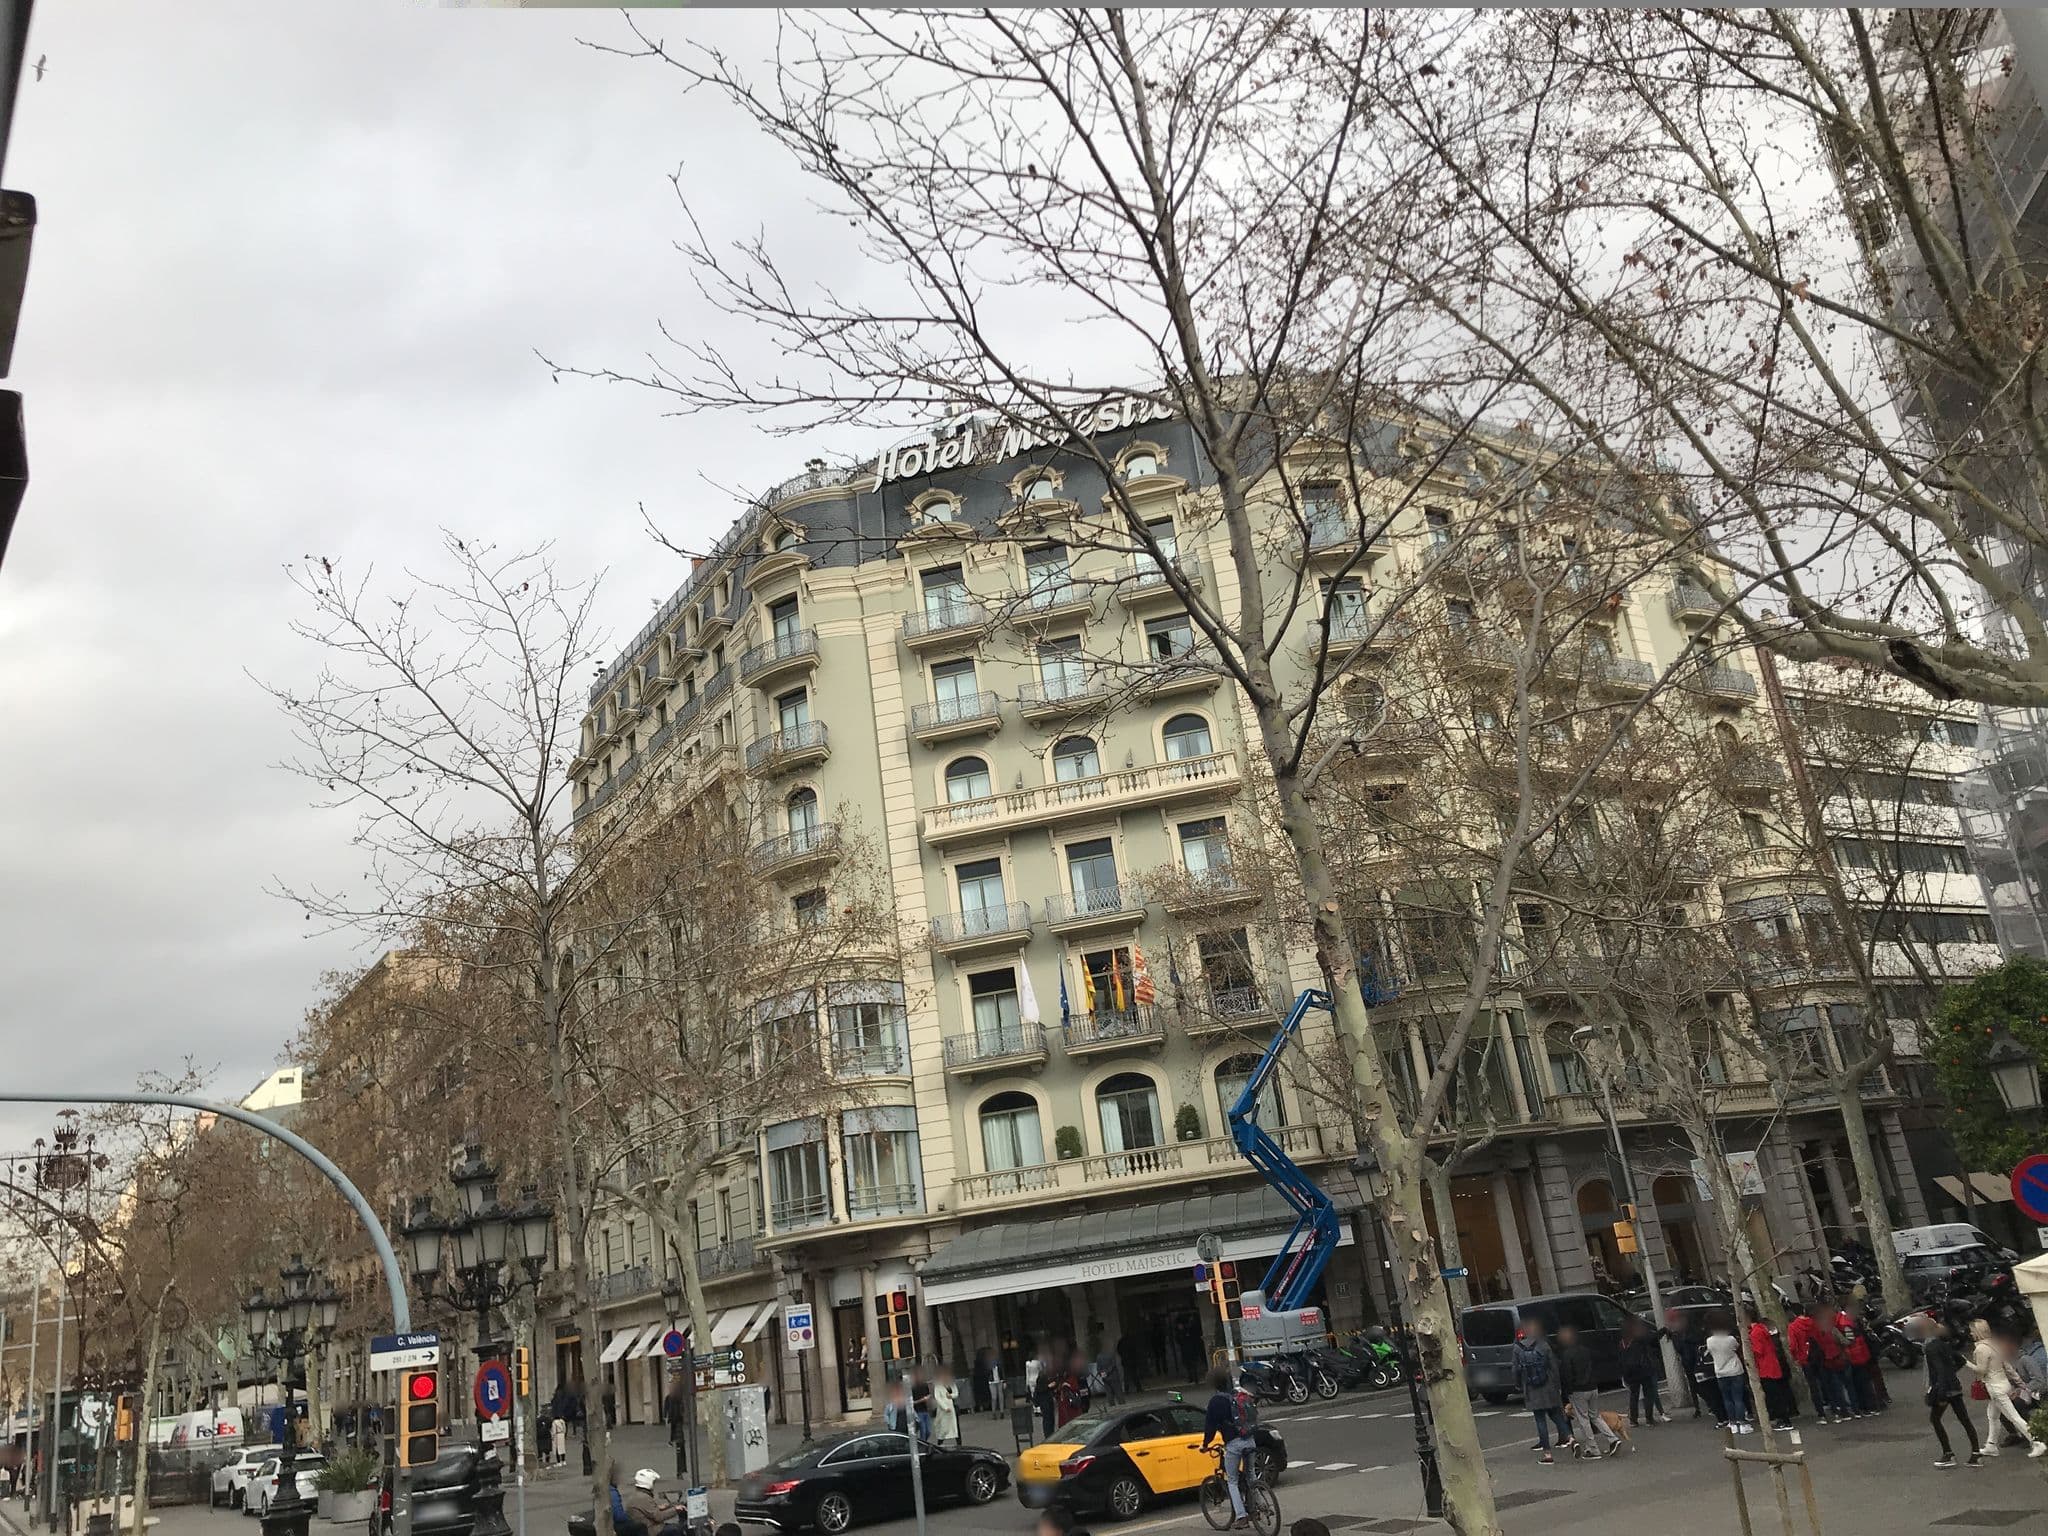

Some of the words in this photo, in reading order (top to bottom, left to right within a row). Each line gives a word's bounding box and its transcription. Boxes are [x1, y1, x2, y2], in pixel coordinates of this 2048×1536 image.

[872, 428, 976, 494] Hotel
[1081, 1262, 1125, 1278] HOTEL
[1126, 1252, 1187, 1272] MAJESTIC
[196, 1422, 237, 1438] FedEx
